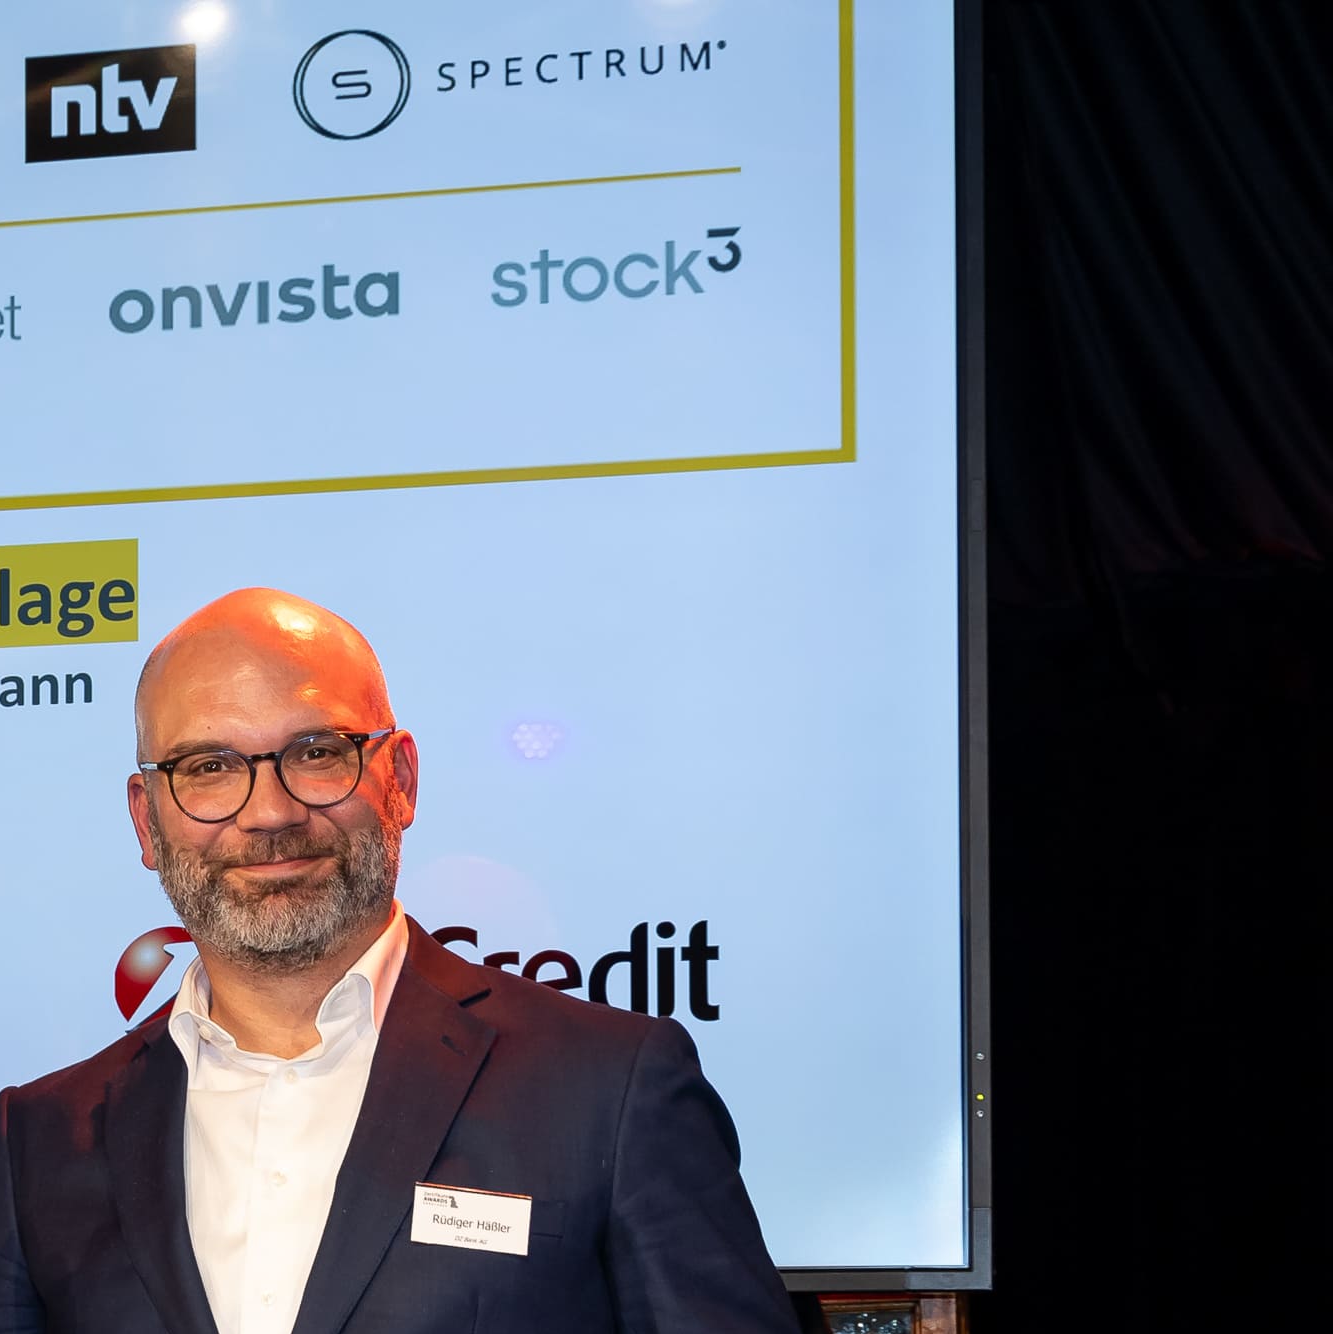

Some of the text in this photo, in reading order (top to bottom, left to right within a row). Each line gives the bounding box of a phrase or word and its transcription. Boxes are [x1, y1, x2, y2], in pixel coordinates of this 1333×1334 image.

[436, 40, 712, 93] SPECTRUM
[50, 63, 179, 139] ntv
[108, 263, 401, 335] onvista
[432, 1213, 512, 1234] Rüdiger Häßler
